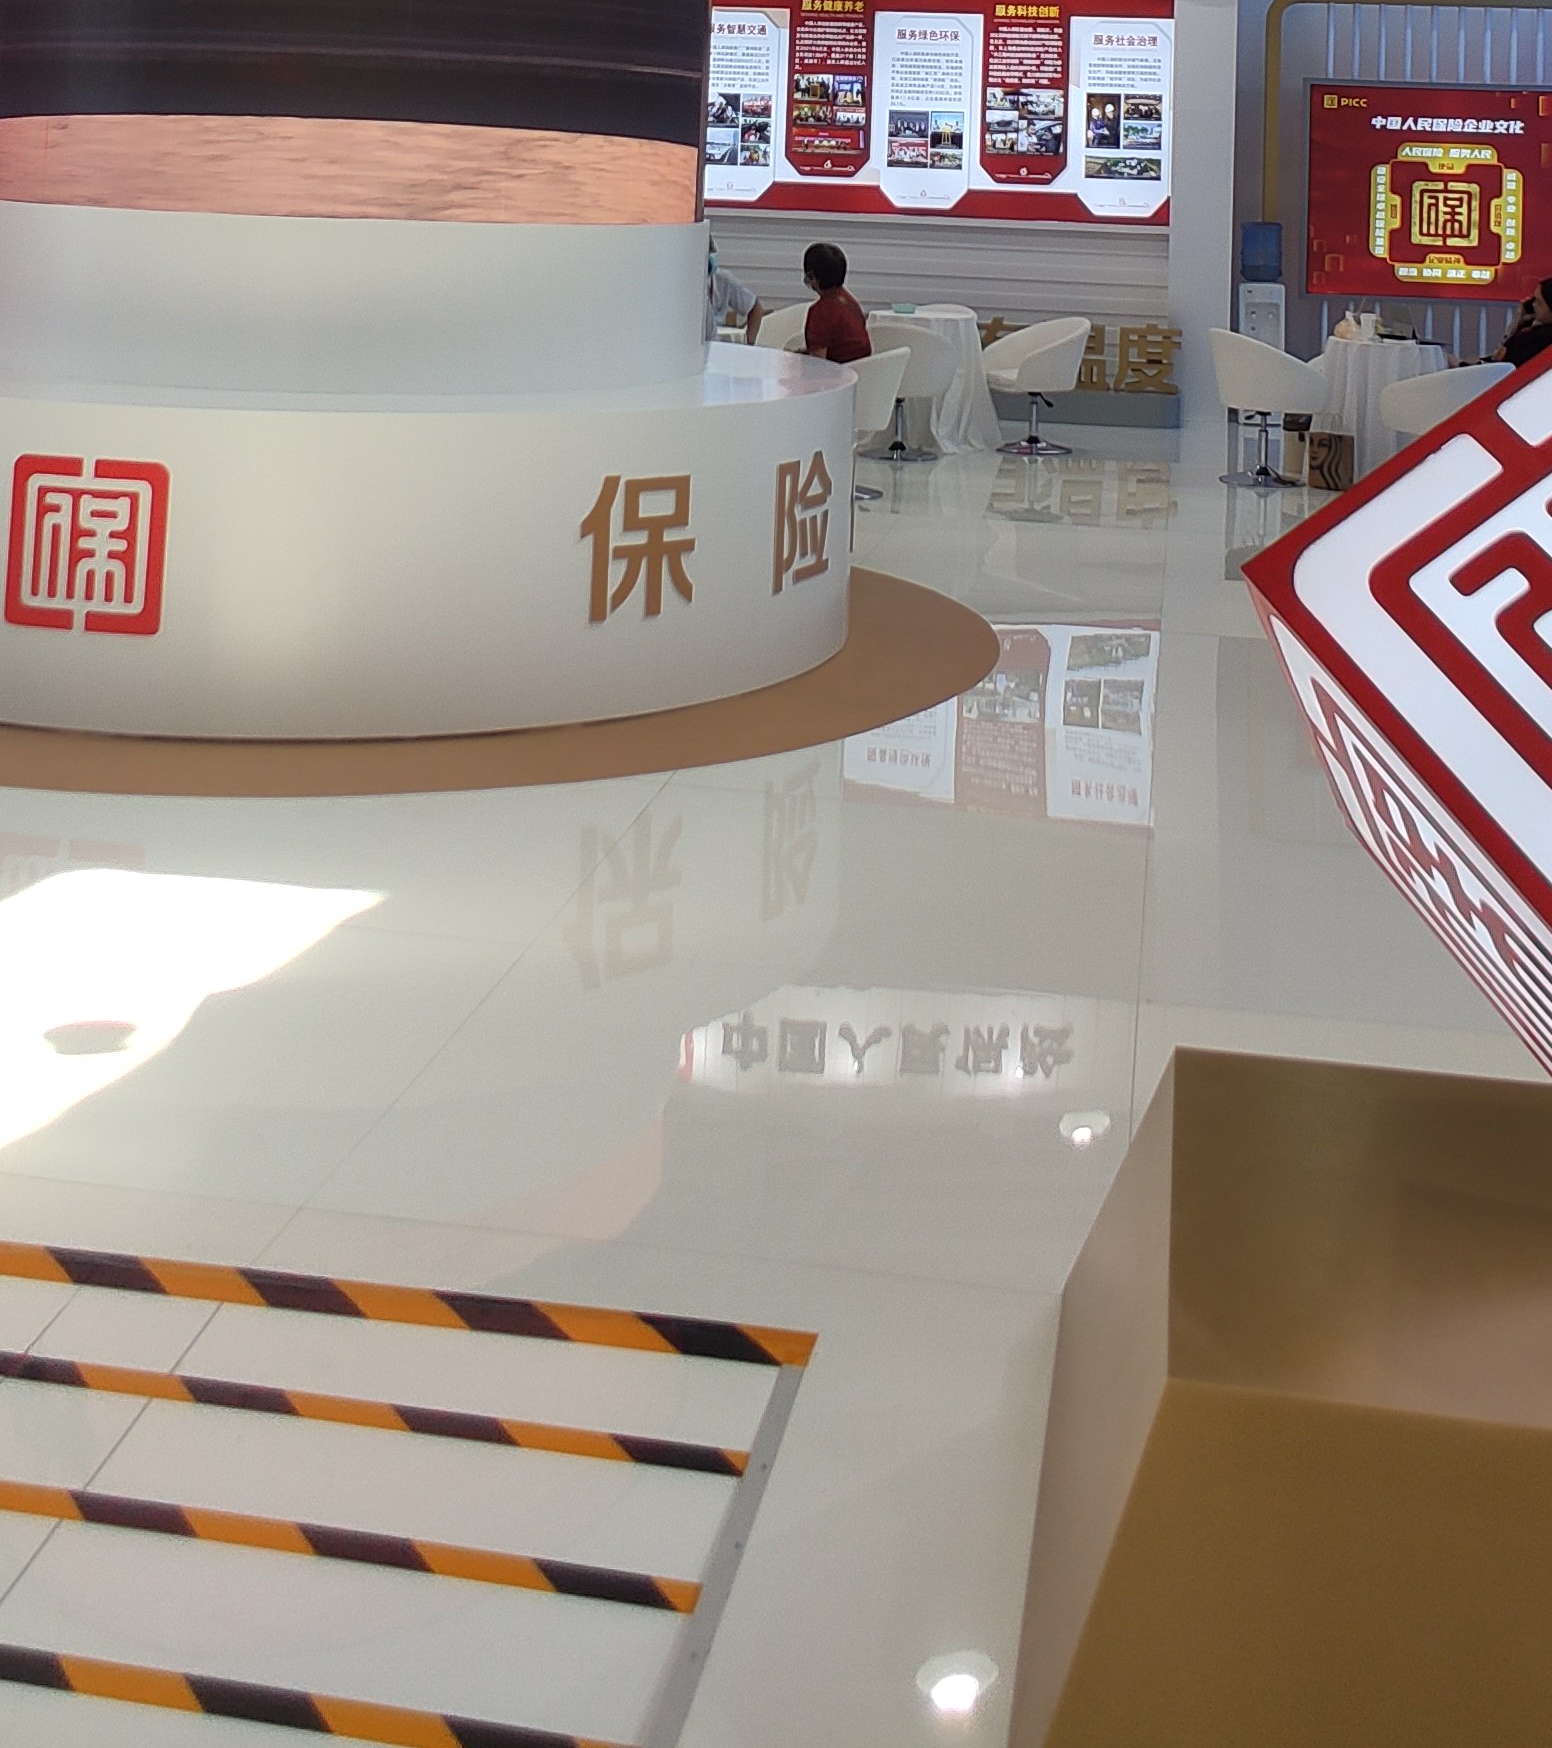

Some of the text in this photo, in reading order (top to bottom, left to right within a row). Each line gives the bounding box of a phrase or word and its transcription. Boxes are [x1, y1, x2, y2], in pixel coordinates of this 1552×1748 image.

[802, 0, 865, 12] 服务健康养老
[995, 4, 1060, 18] 服务科技创新
[896, 29, 960, 41] 服务绿色环保
[1093, 35, 1158, 47] 服务社会治理
[1341, 97, 1367, 108] PICC
[1371, 116, 1525, 134] 中国人民保险企业文化
